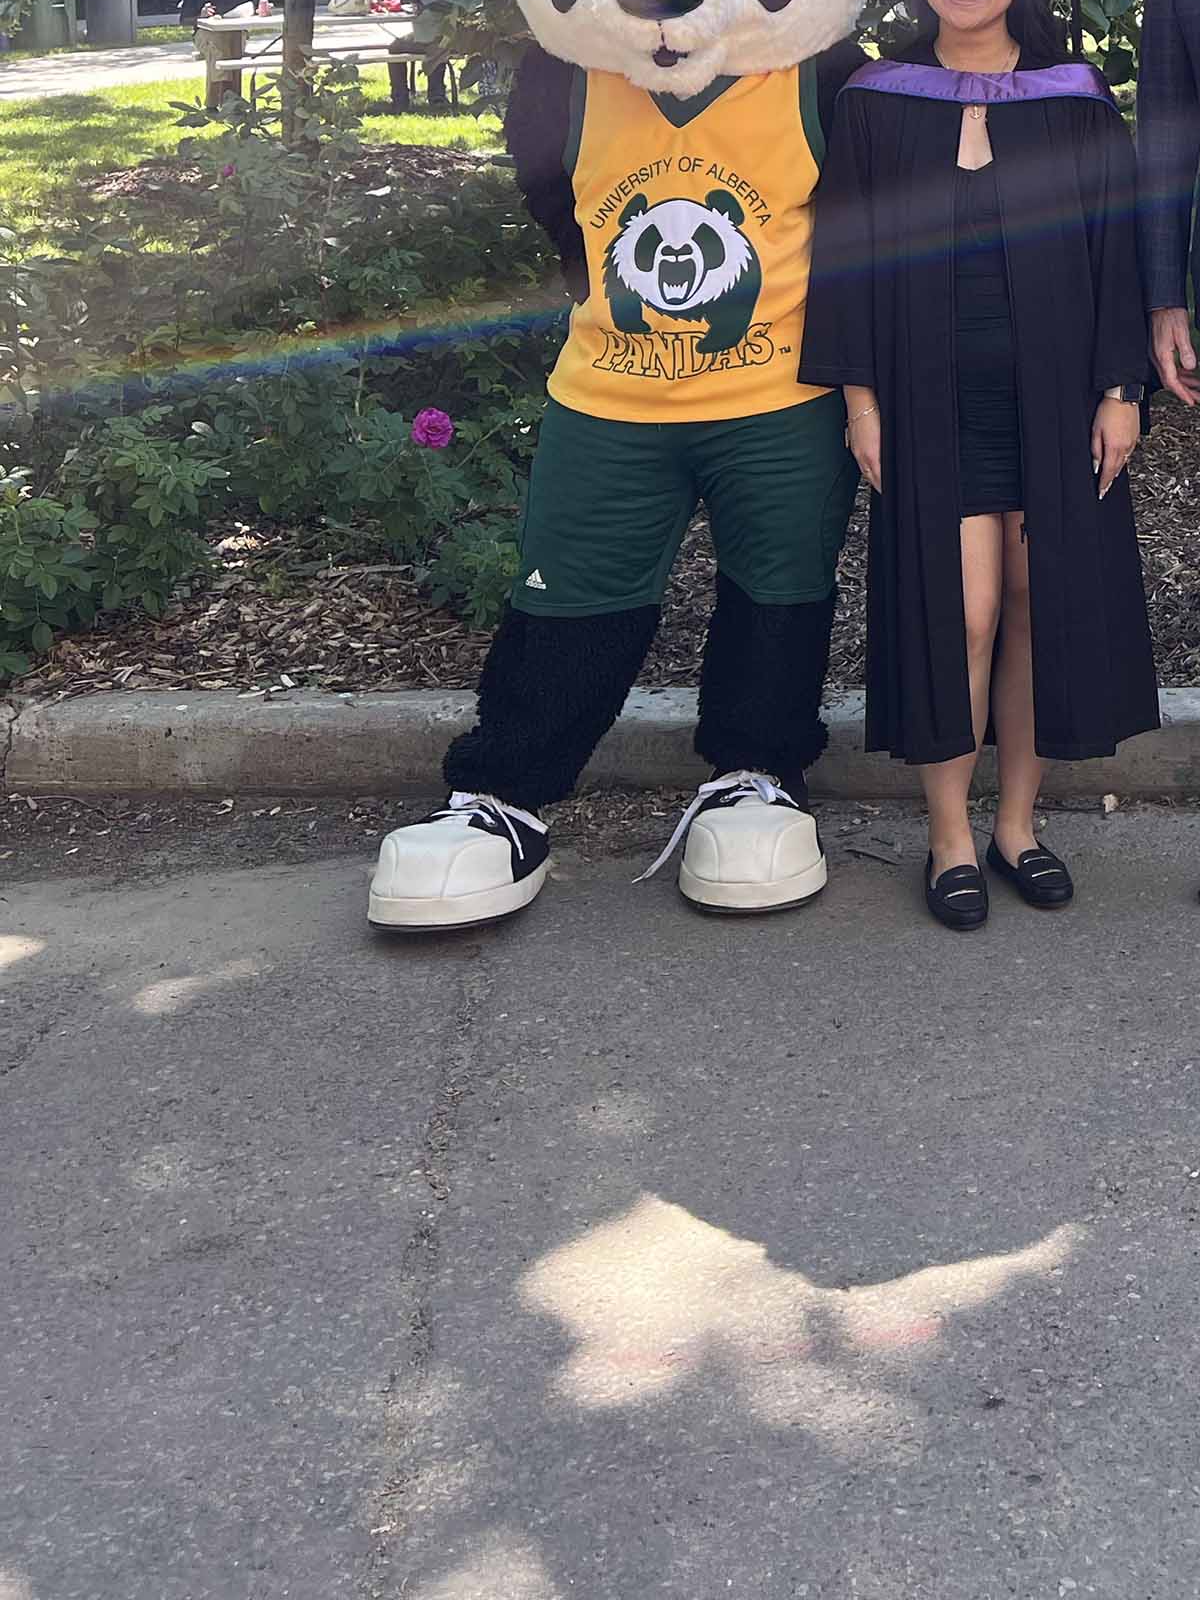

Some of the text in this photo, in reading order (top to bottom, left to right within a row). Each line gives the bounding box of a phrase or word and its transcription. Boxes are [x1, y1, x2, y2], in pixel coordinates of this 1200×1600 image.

[590, 155, 772, 230] UNIVERSITY OF ALBERTA
